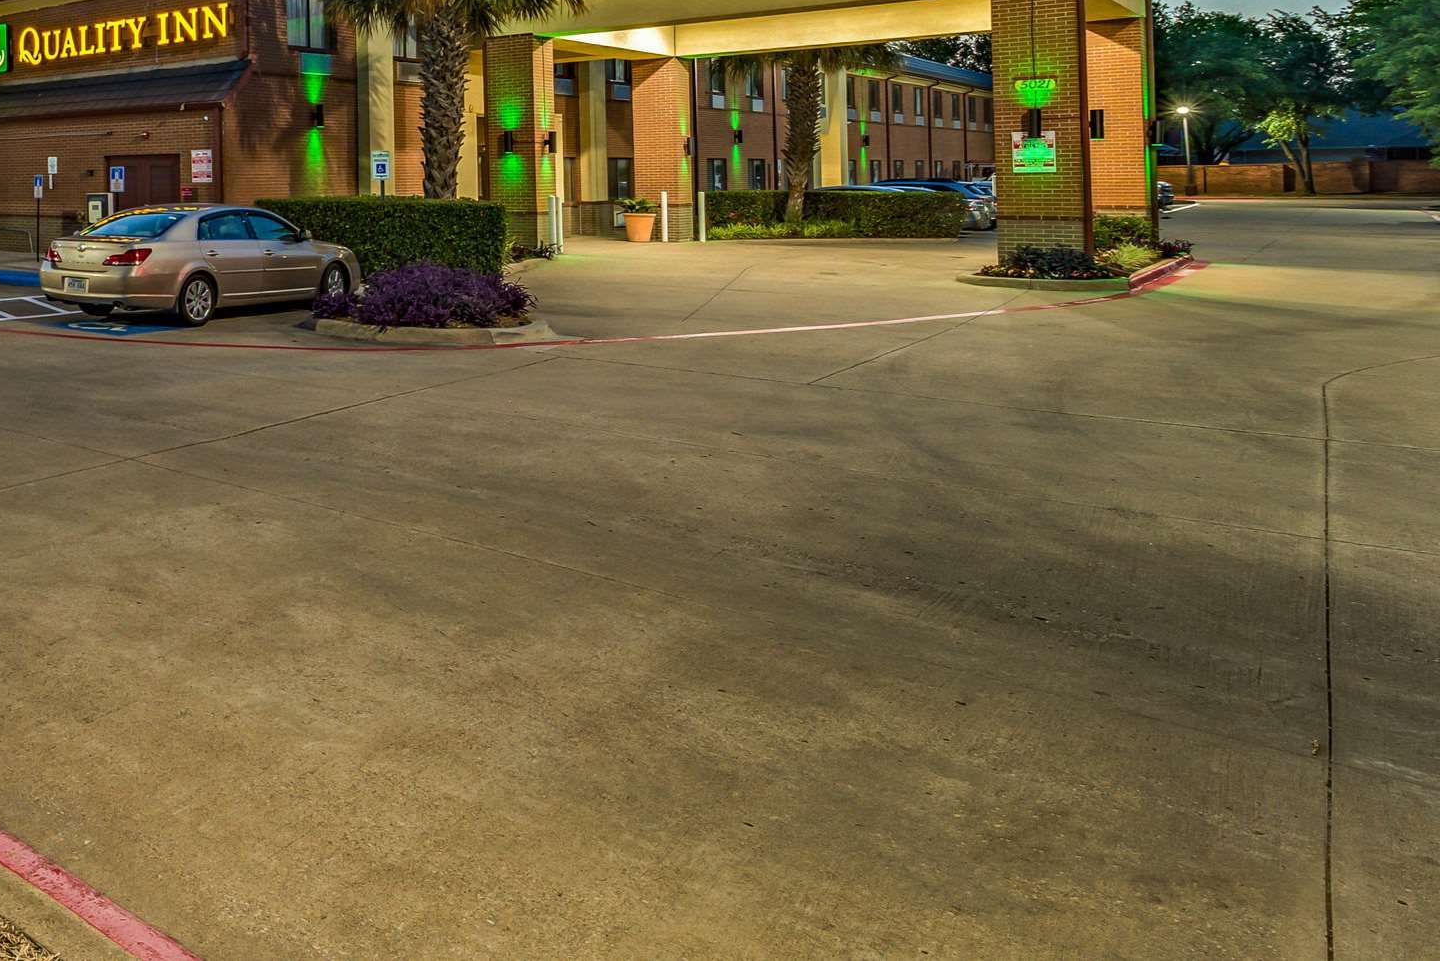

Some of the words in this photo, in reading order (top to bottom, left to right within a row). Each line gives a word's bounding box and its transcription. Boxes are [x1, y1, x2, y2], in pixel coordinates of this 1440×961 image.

[19, 16, 147, 65] QUALITY
[157, 2, 229, 46] INN
[1020, 79, 1051, 89] 5021
